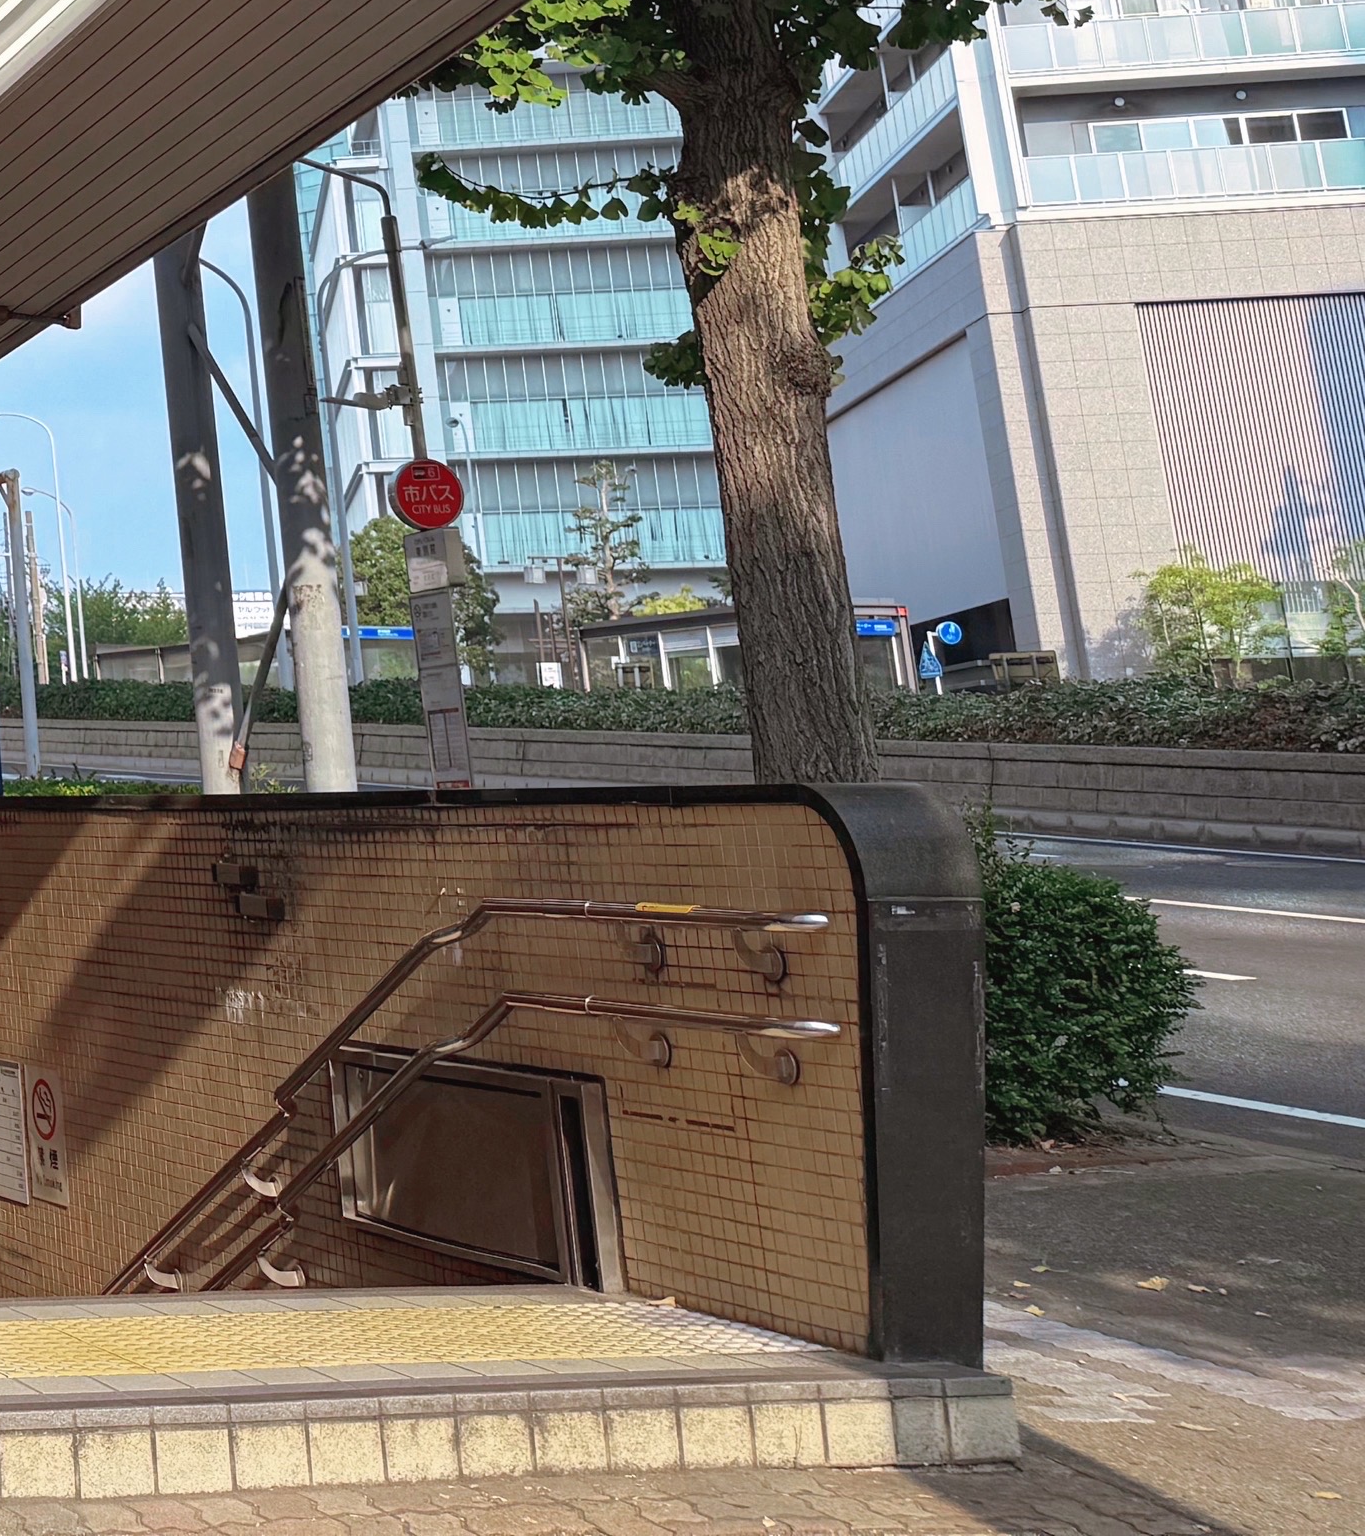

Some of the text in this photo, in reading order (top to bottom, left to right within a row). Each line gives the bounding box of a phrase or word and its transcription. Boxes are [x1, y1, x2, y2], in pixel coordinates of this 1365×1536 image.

[403, 484, 455, 503] 市バス
[412, 504, 451, 515] CITY BUS
